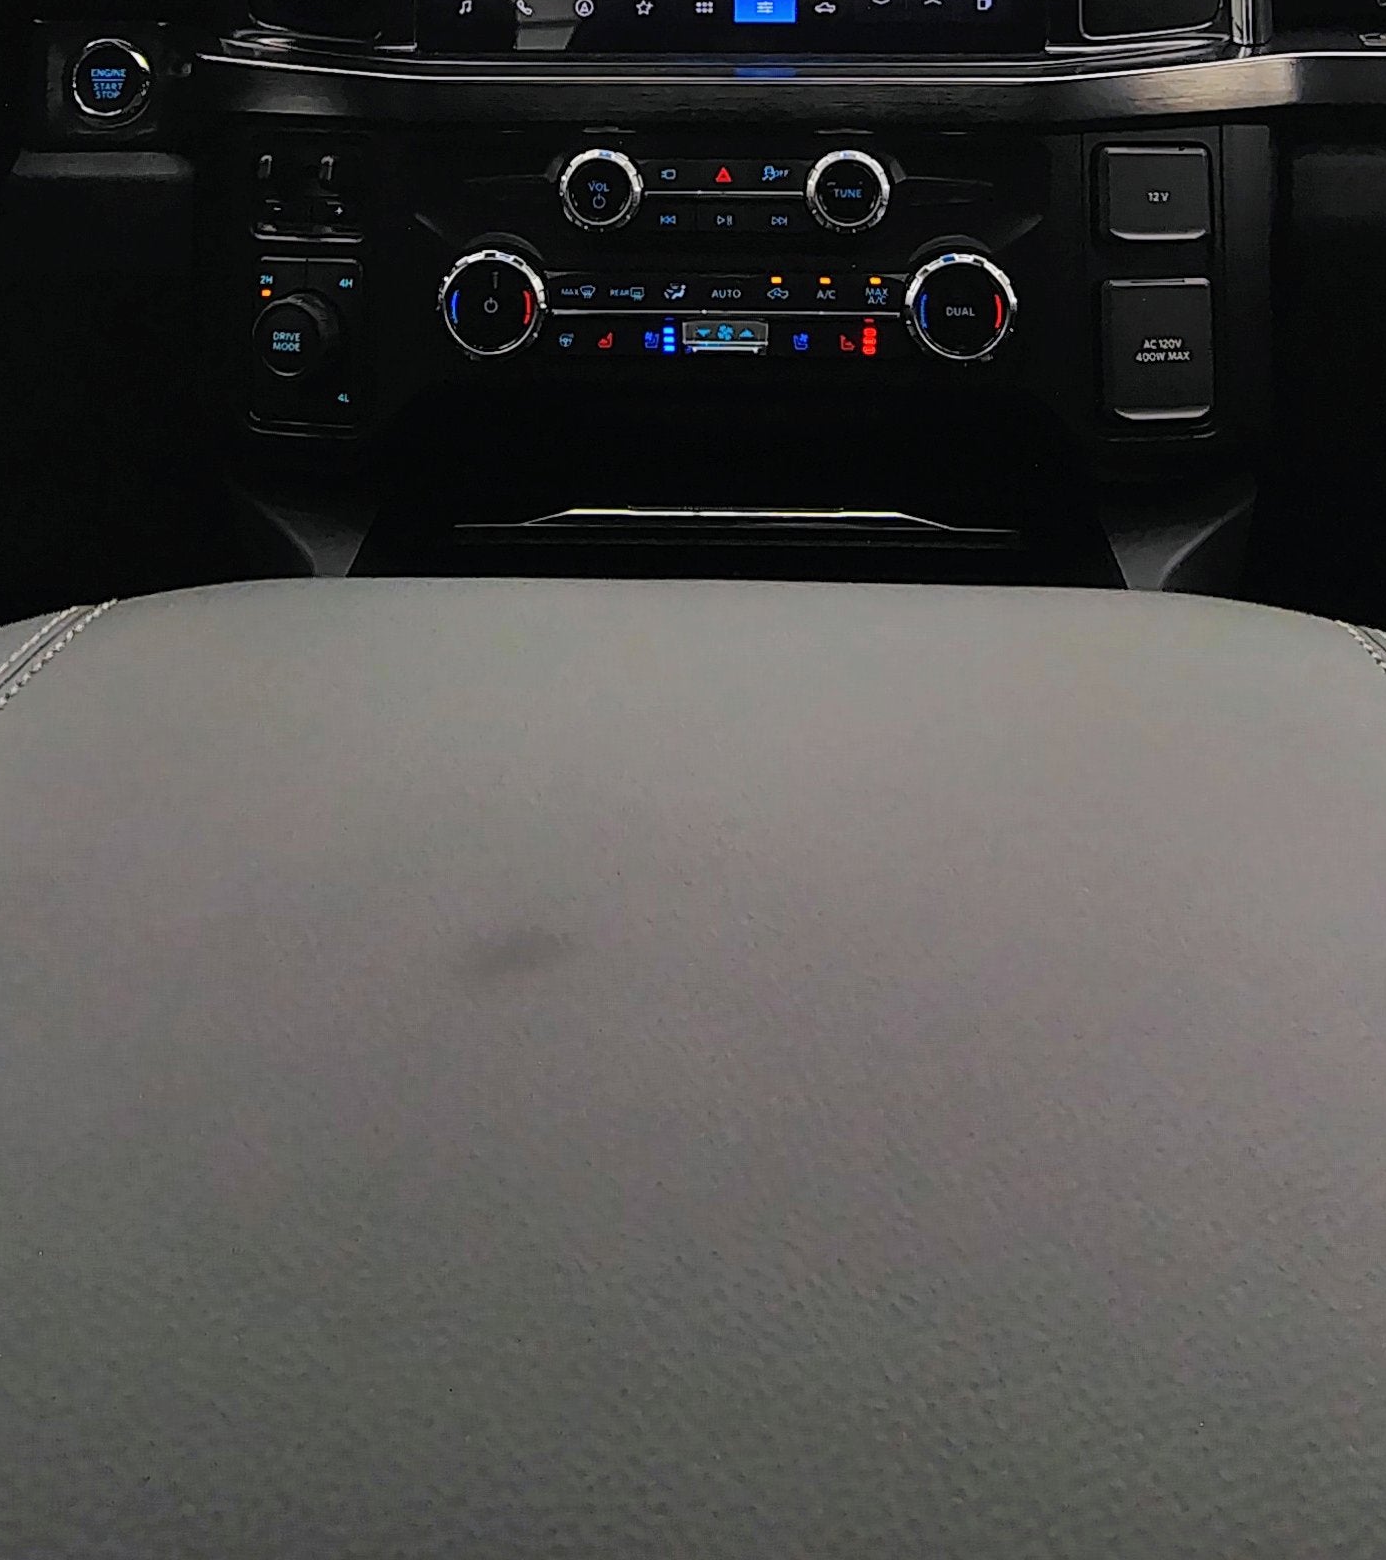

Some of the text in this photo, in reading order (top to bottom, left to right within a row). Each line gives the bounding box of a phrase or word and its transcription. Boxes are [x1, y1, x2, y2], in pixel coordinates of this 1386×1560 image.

[90, 68, 127, 78] ENGINE
[93, 82, 124, 90] START
[95, 90, 121, 100] STOP
[588, 182, 610, 192] VOL
[834, 188, 863, 199] TUNE
[260, 275, 273, 285] 2H
[339, 278, 354, 289] 4H
[711, 289, 742, 299] AUTO
[816, 290, 837, 300] A/C
[865, 288, 889, 297] MAX
[867, 296, 887, 306] A/C
[945, 306, 976, 317] DUAL
[273, 331, 301, 342] DRIVE
[273, 342, 301, 352] MODE
[1143, 338, 1183, 350] AC 120V
[1135, 351, 1191, 362] 400W MAX
[337, 393, 350, 403] 4L
